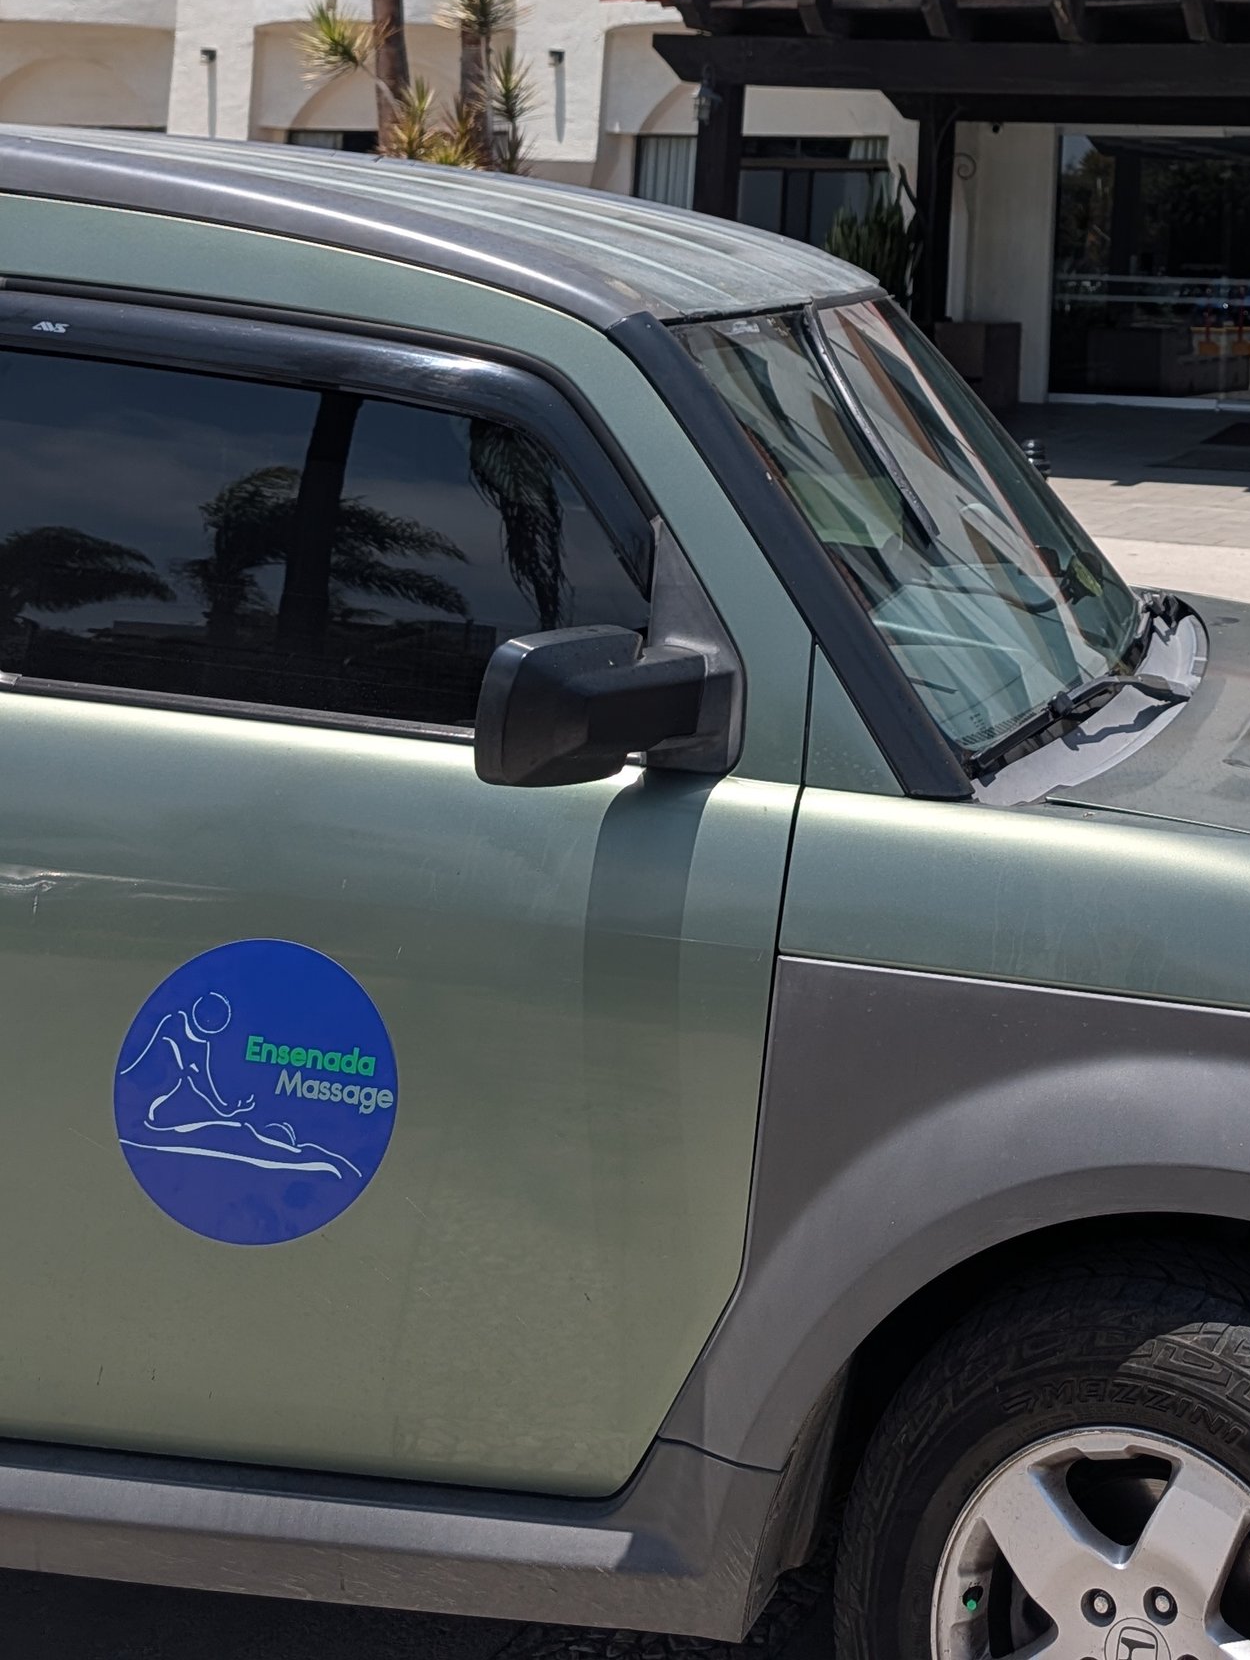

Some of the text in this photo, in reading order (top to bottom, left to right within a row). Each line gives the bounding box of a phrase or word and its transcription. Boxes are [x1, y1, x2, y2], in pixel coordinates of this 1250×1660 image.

[245, 1035, 376, 1077] Ensenada
[274, 1068, 394, 1114] Massage
[1042, 1376, 1248, 1444] MAZZINI
